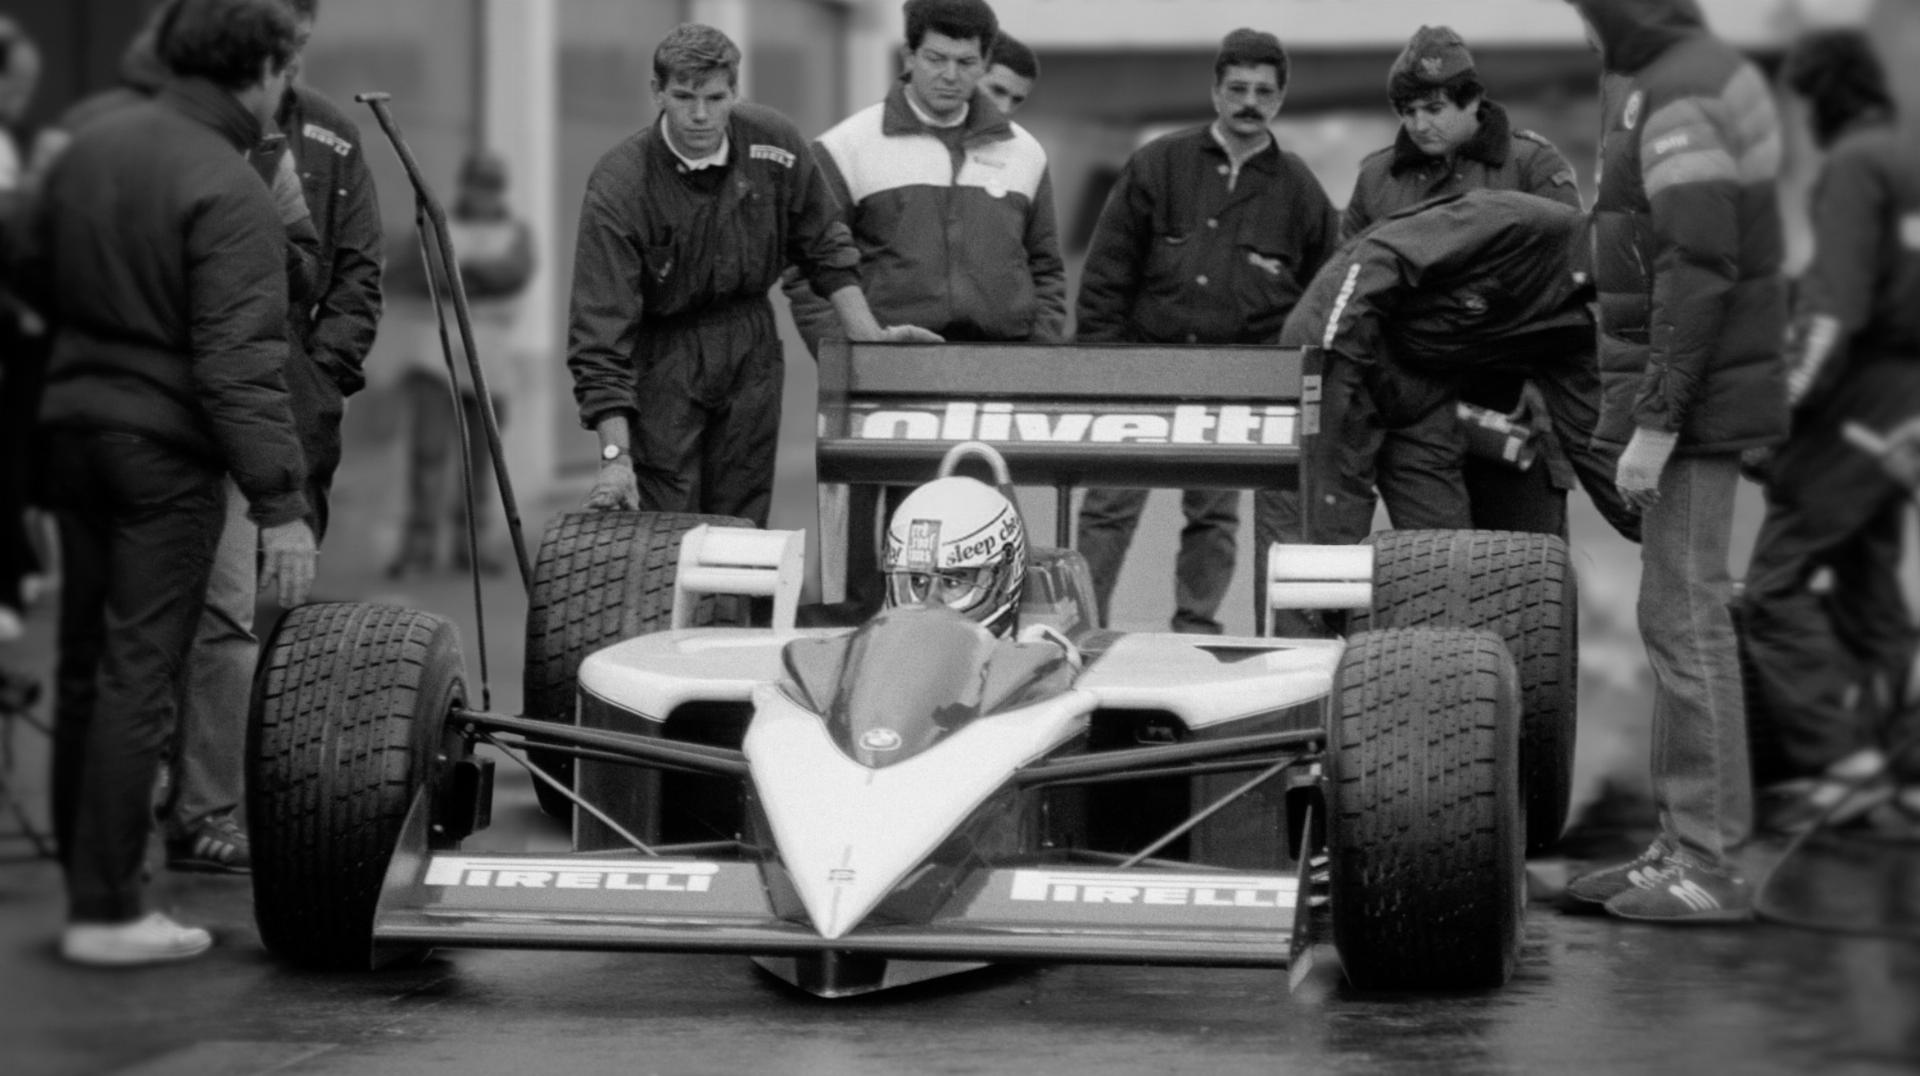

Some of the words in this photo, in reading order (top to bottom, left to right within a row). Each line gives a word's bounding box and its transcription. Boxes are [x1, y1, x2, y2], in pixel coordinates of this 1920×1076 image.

[861, 402, 1297, 444] olivetti
[946, 535, 996, 567] sleep
[424, 856, 719, 892] PIRELLI
[1010, 869, 1299, 908] PIRELLI
